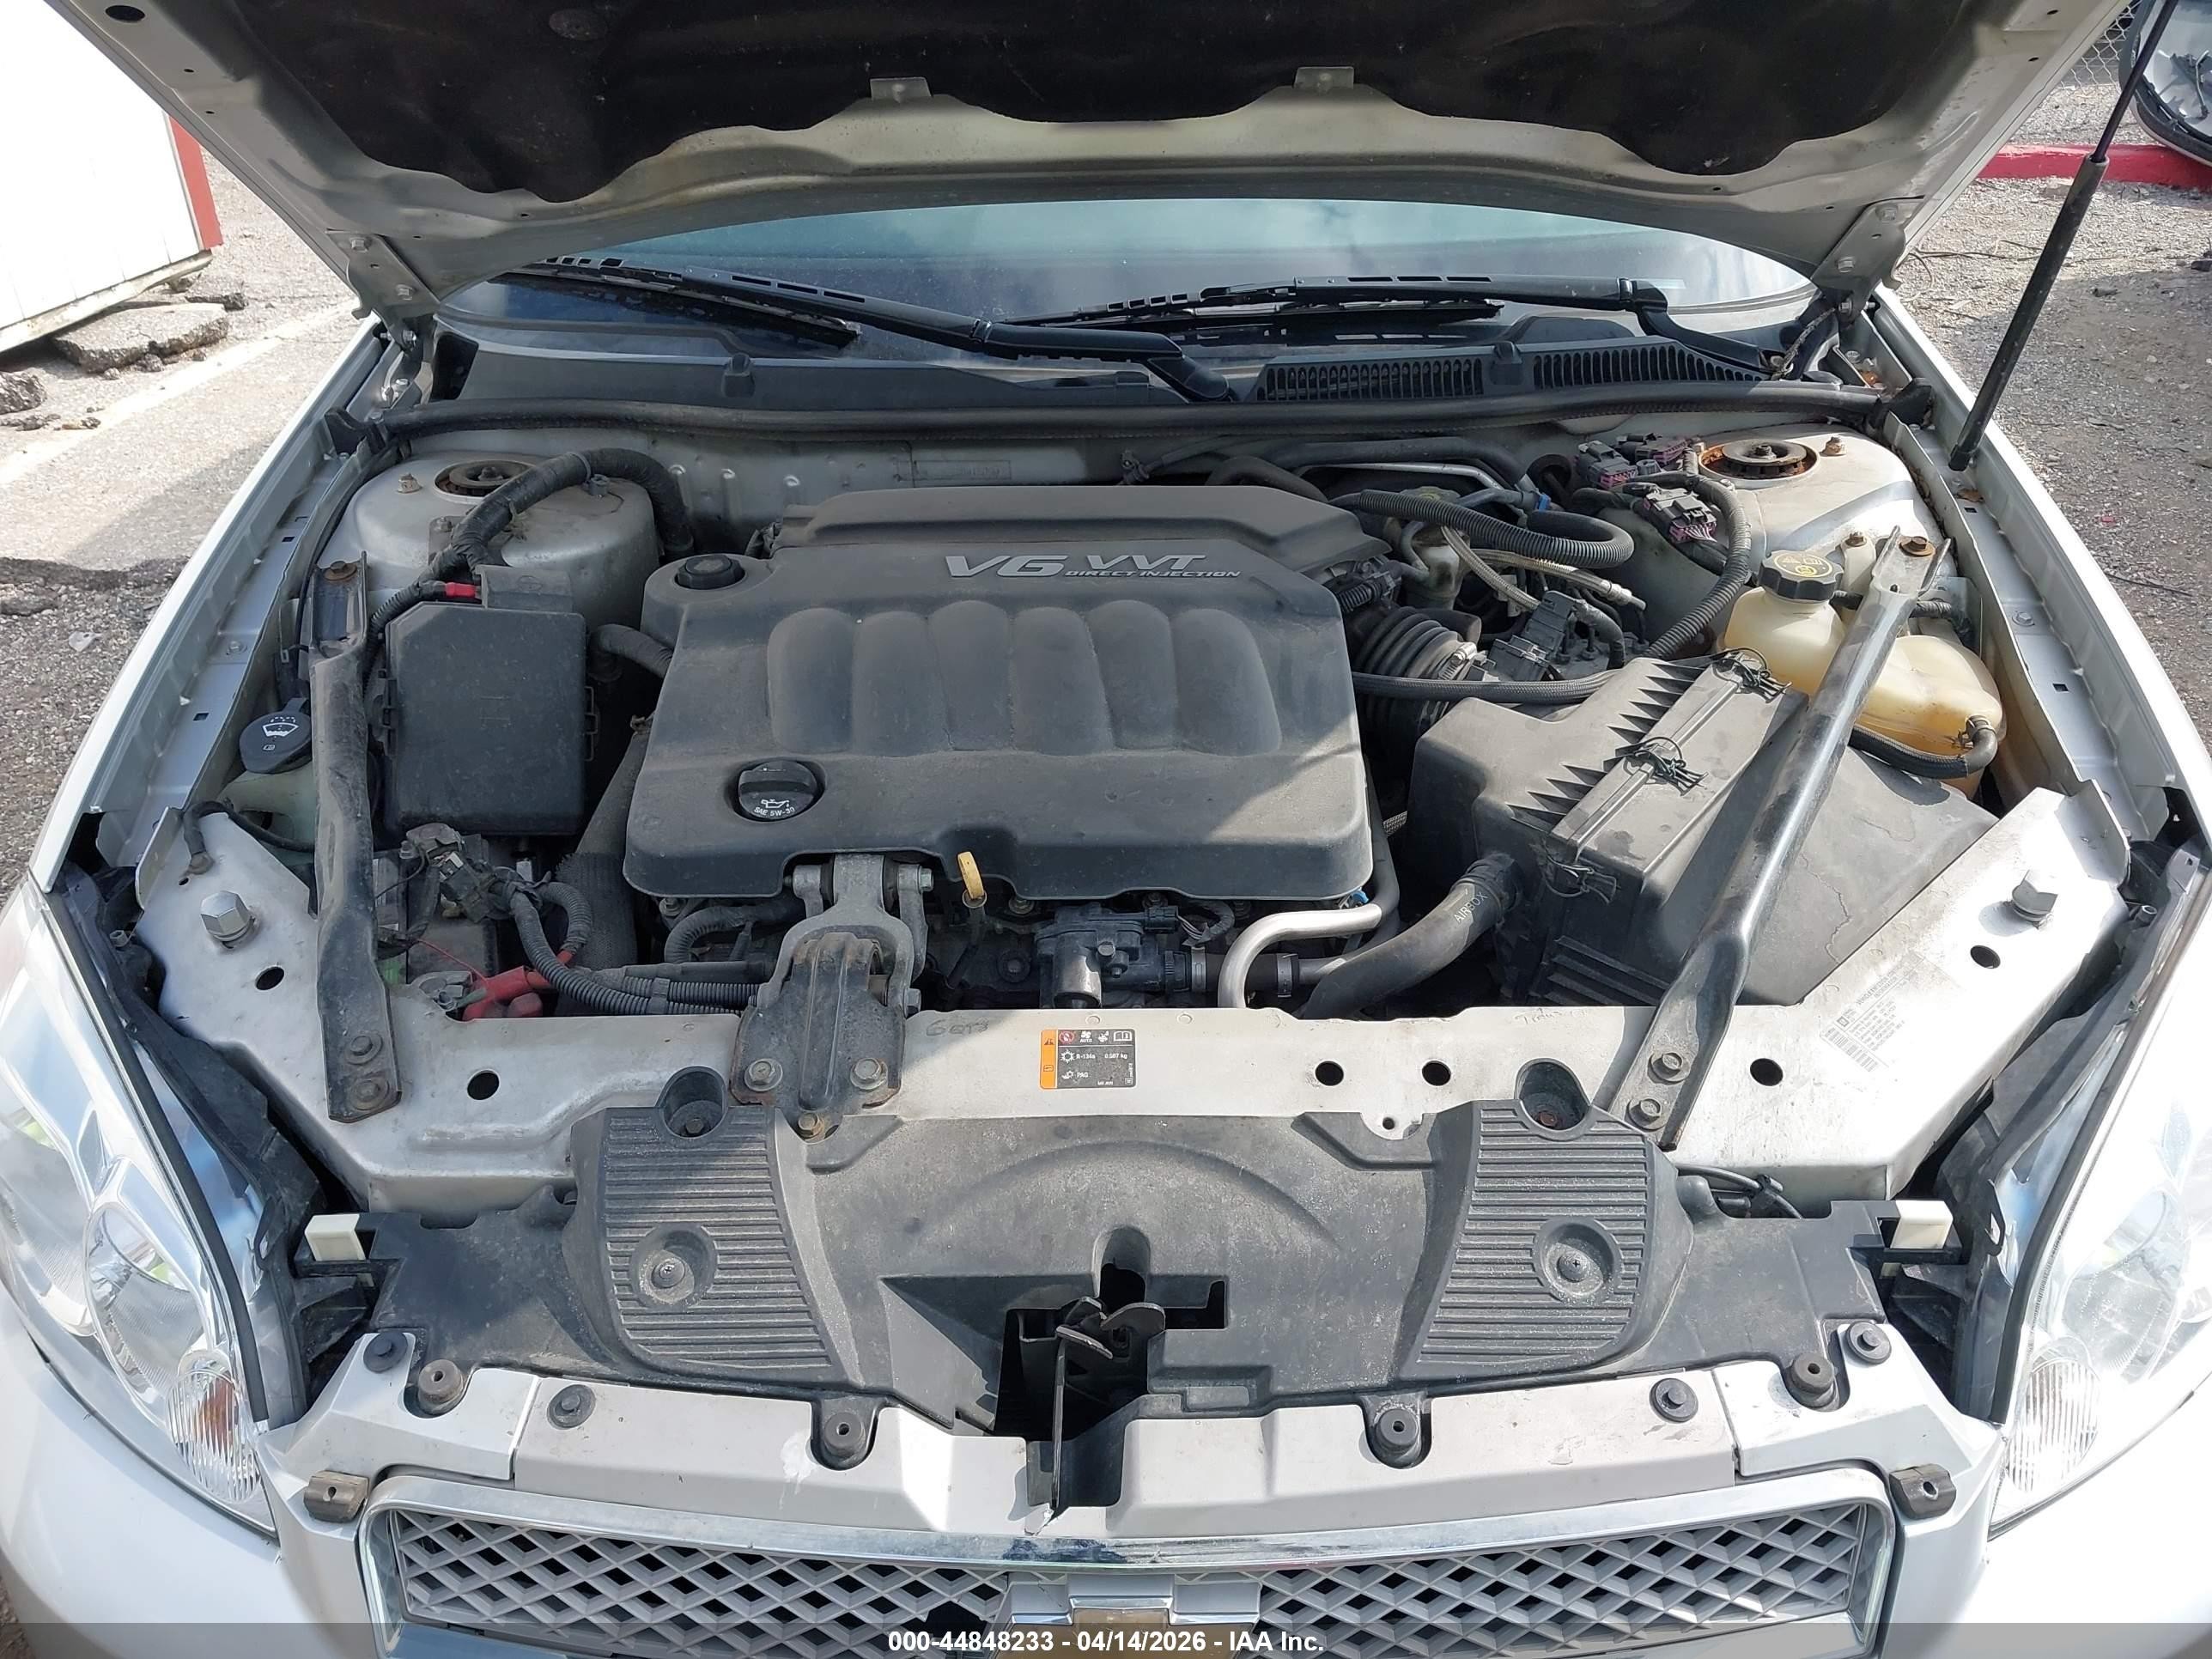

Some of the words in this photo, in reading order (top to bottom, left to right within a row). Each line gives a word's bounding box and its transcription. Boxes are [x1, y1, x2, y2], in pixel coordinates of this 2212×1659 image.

[945, 556, 1069, 577] V6
[1086, 555, 1206, 570] VVT
[754, 806, 768, 816] SAE
[769, 806, 795, 817] 5W-30
[1454, 891, 1488, 923] AIRBOX
